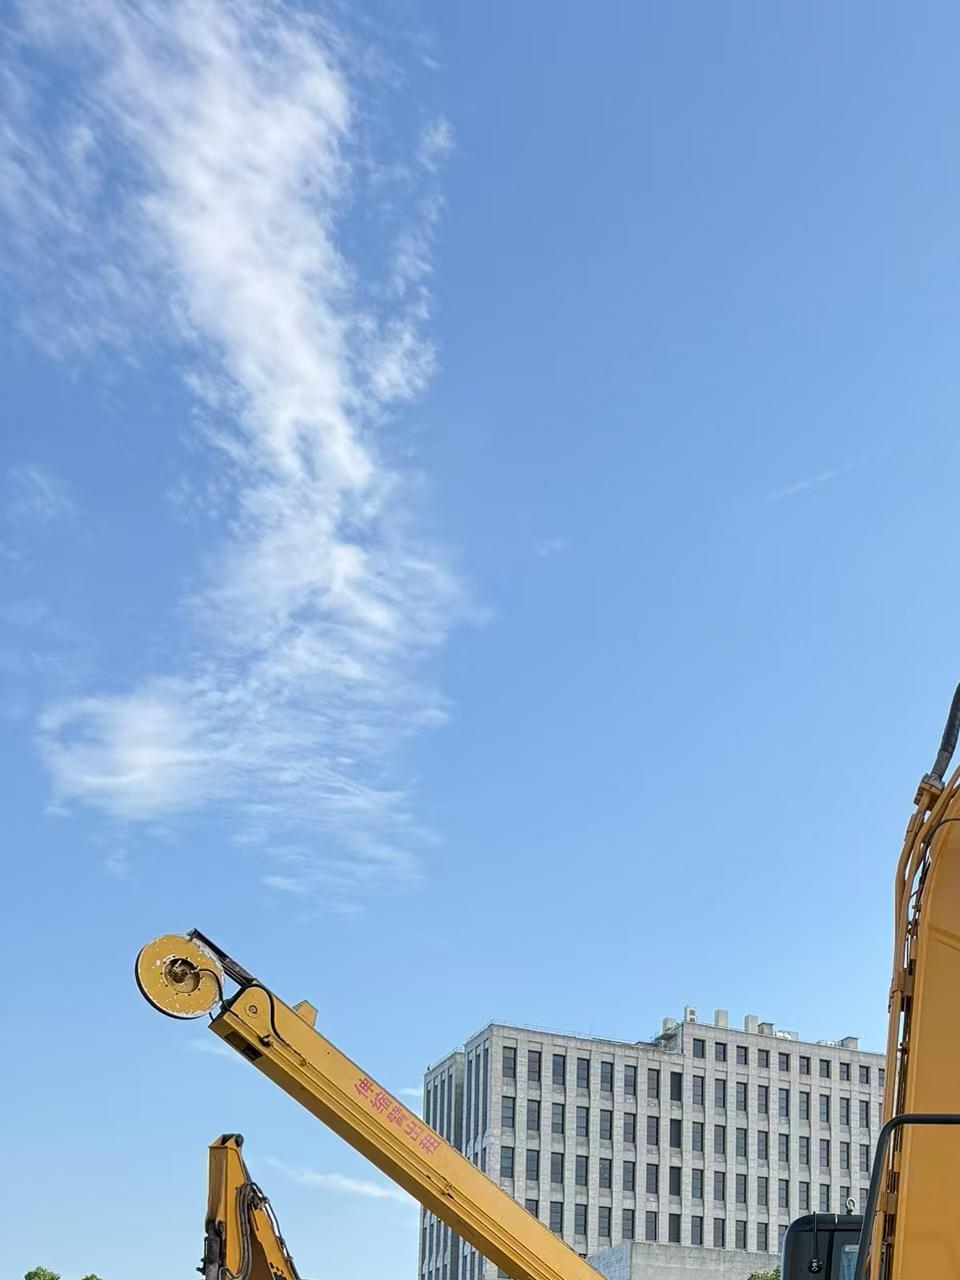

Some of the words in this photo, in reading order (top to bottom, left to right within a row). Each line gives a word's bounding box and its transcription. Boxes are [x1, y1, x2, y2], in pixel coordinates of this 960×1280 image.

[354, 1078, 442, 1154] 伸缩臂出租
